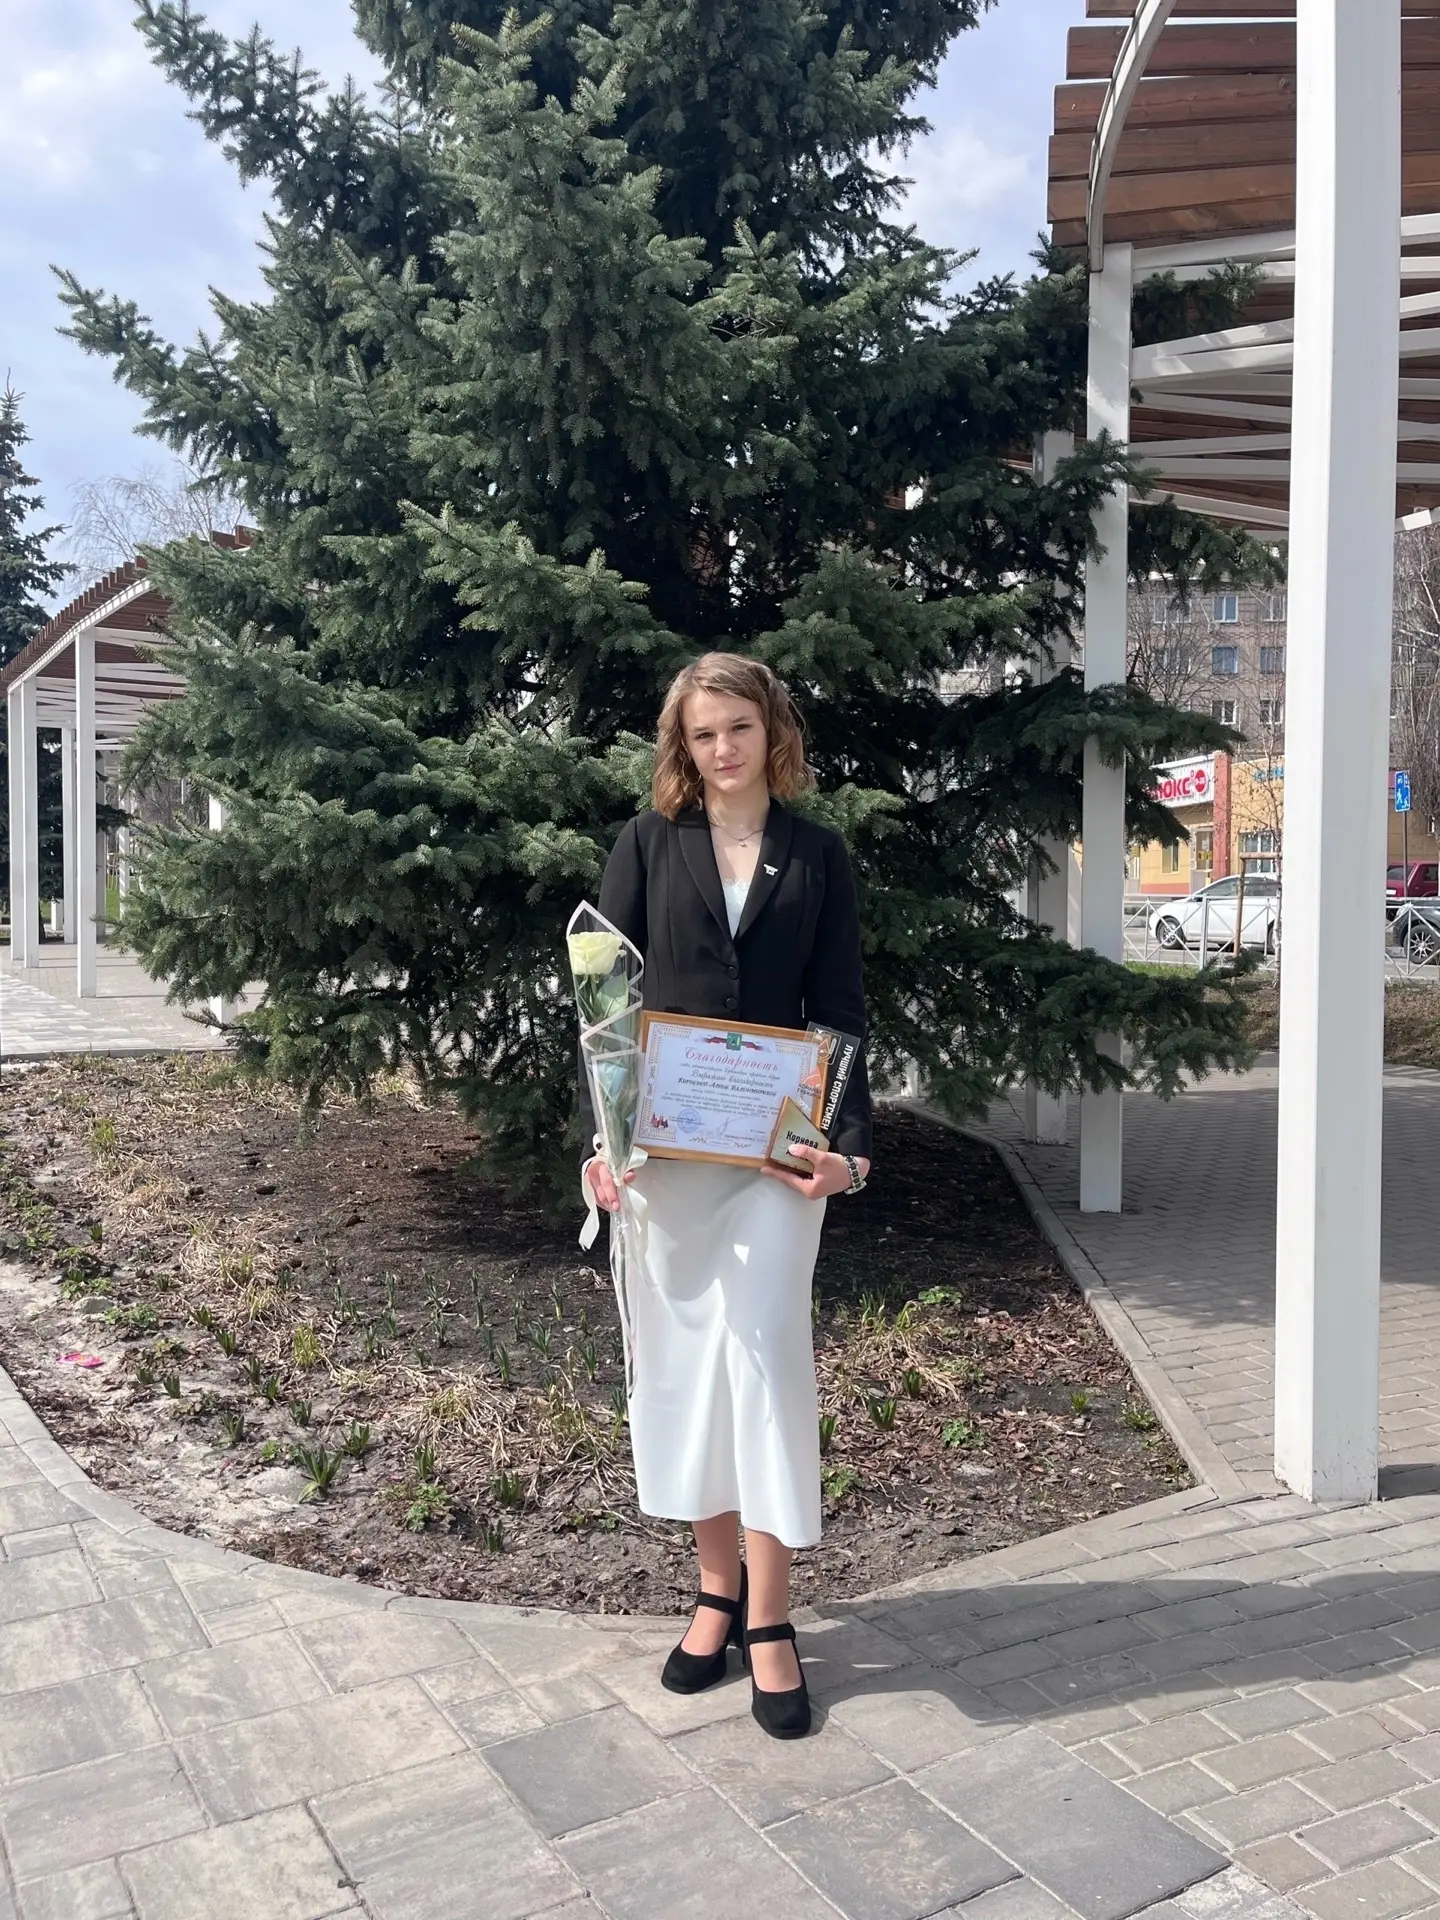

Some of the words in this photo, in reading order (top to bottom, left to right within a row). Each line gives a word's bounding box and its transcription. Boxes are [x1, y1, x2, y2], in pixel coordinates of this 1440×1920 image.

[685, 1046, 779, 1071] Благодарность
[836, 1044, 854, 1080] ЛУЧШИЙ
[820, 1081, 843, 1130] СПОРТСМЕН
[786, 1130, 819, 1149] Корнева
